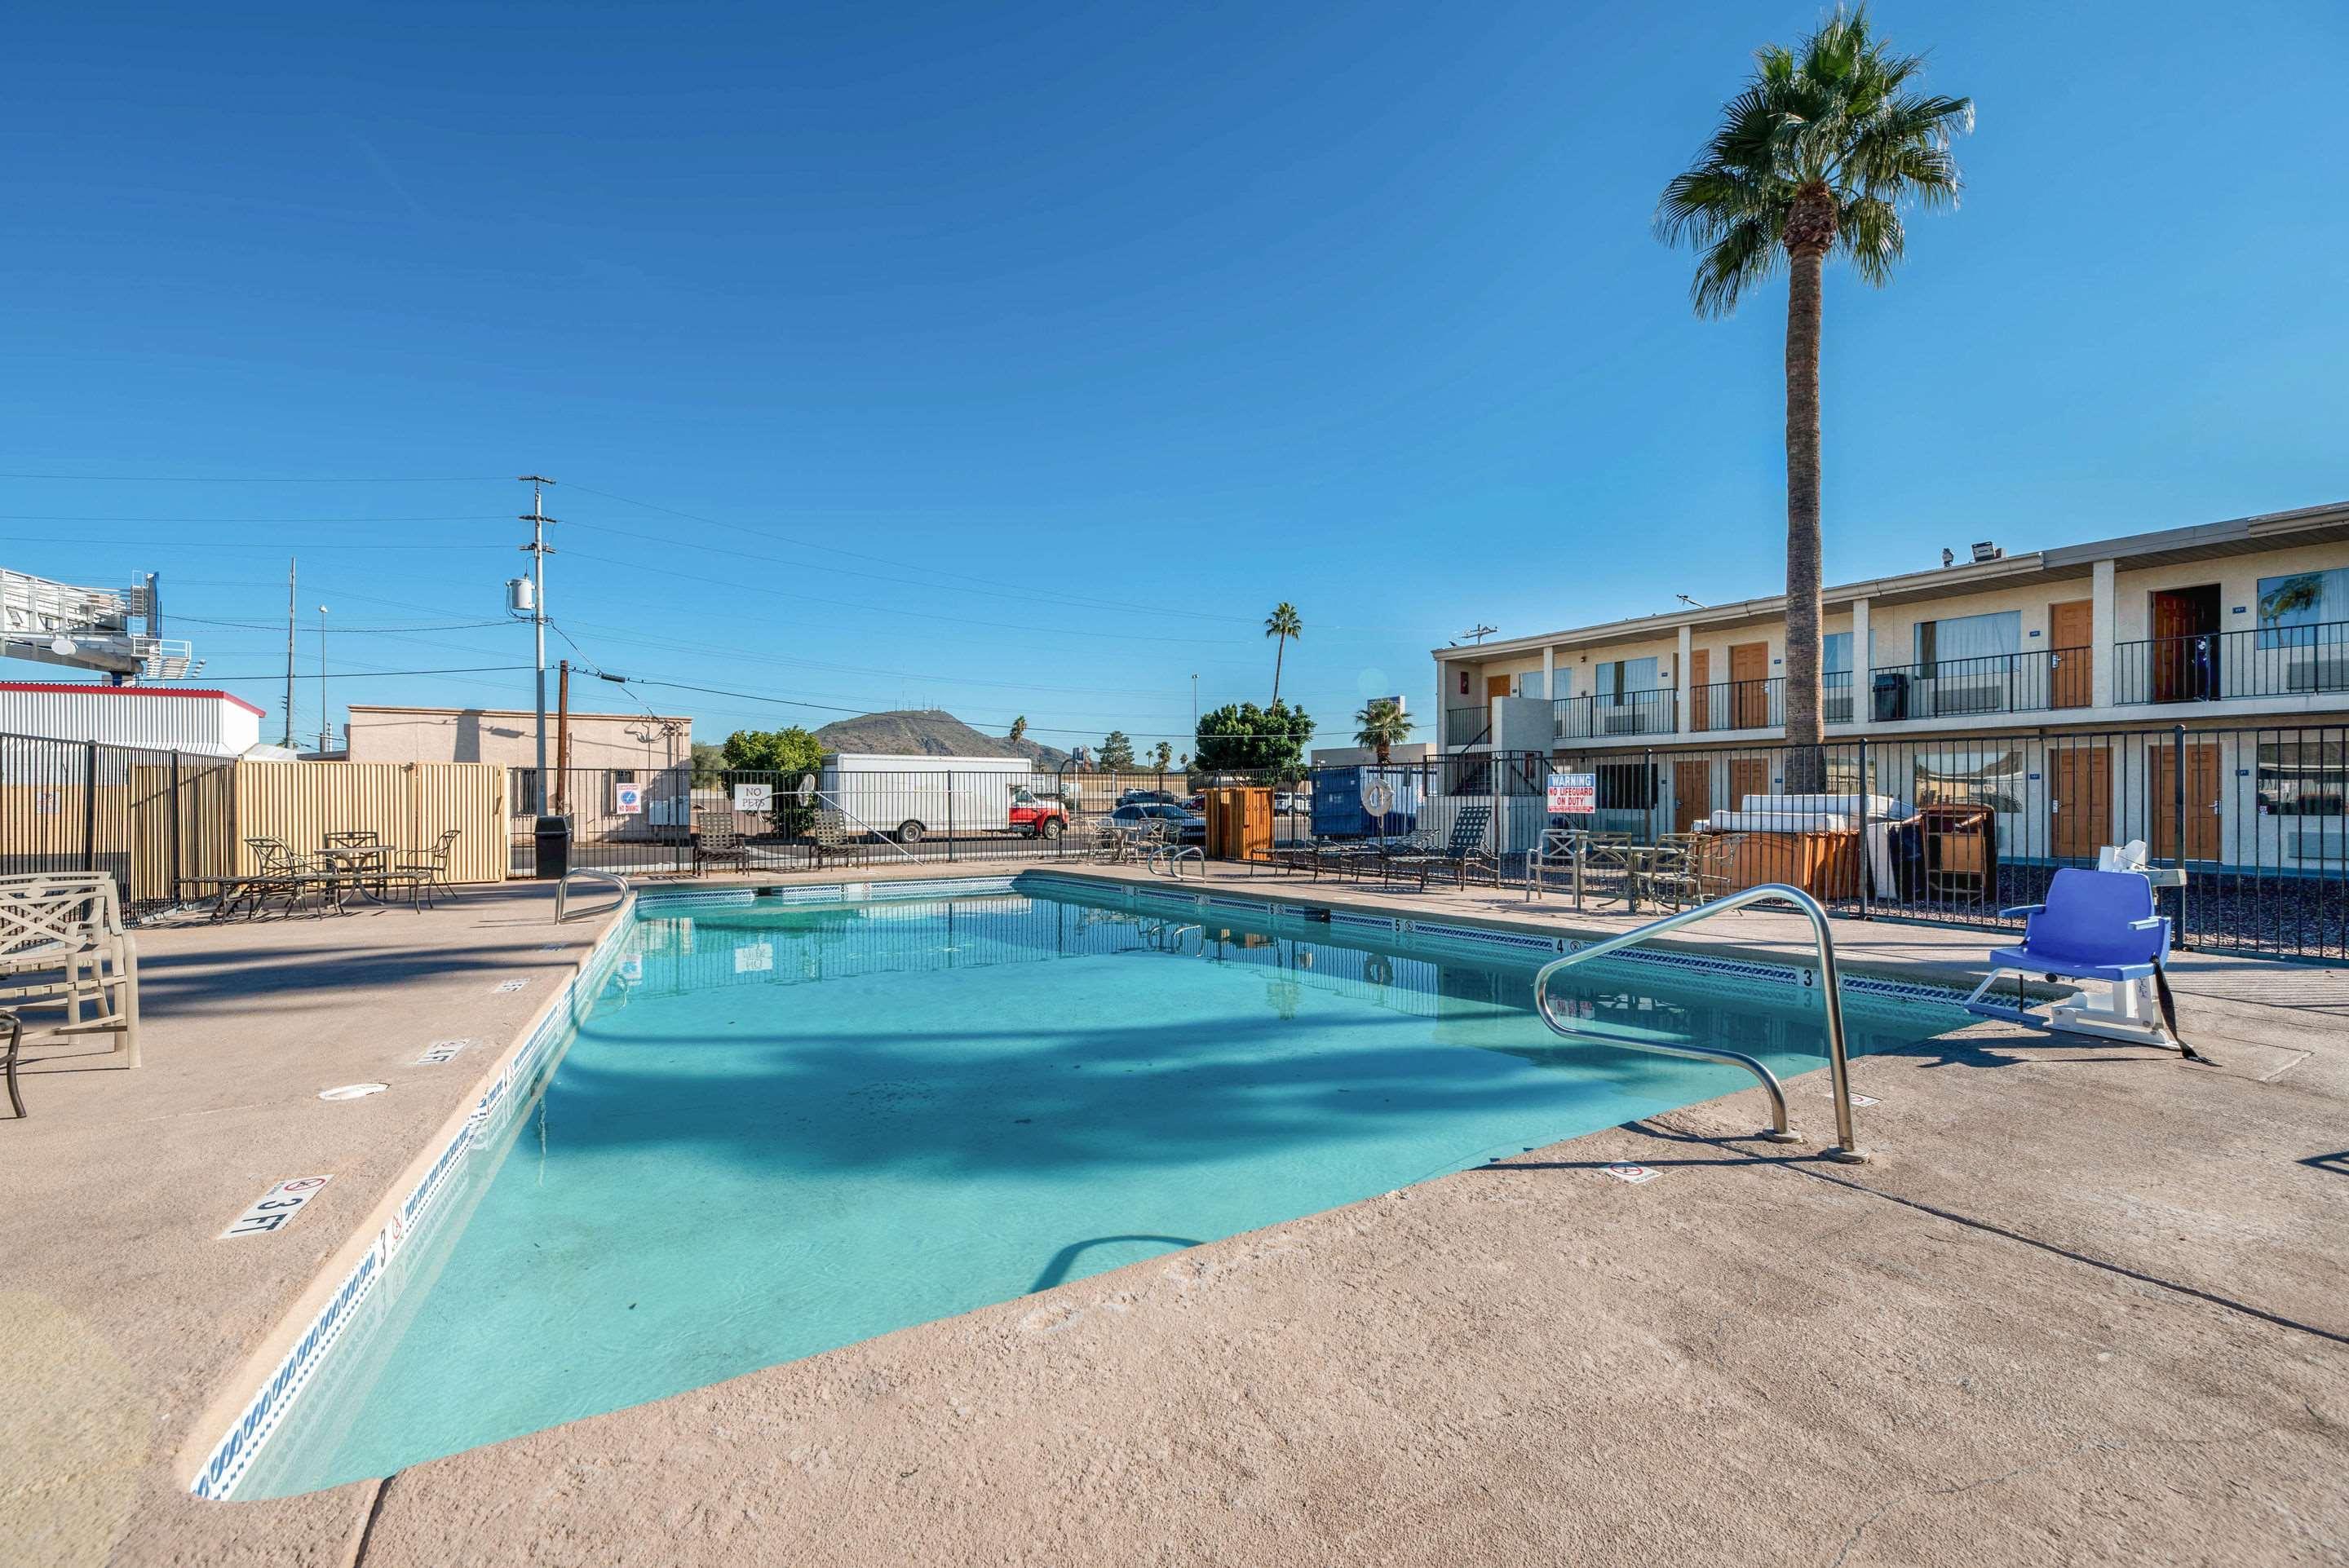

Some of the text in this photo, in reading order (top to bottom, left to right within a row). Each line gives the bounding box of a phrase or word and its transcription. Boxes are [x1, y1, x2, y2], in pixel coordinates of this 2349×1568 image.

[1551, 775, 1591, 787] WARNING
[745, 788, 762, 797] NO
[1549, 788, 1593, 796] NO LIFEGUARD
[1557, 797, 1584, 806] ON DUTY
[1270, 903, 1274, 914] 6
[1395, 919, 1400, 932] 5
[1557, 939, 1564, 954] 4
[1803, 970, 1812, 987] 3
[230, 1198, 303, 1233] 3 FT
